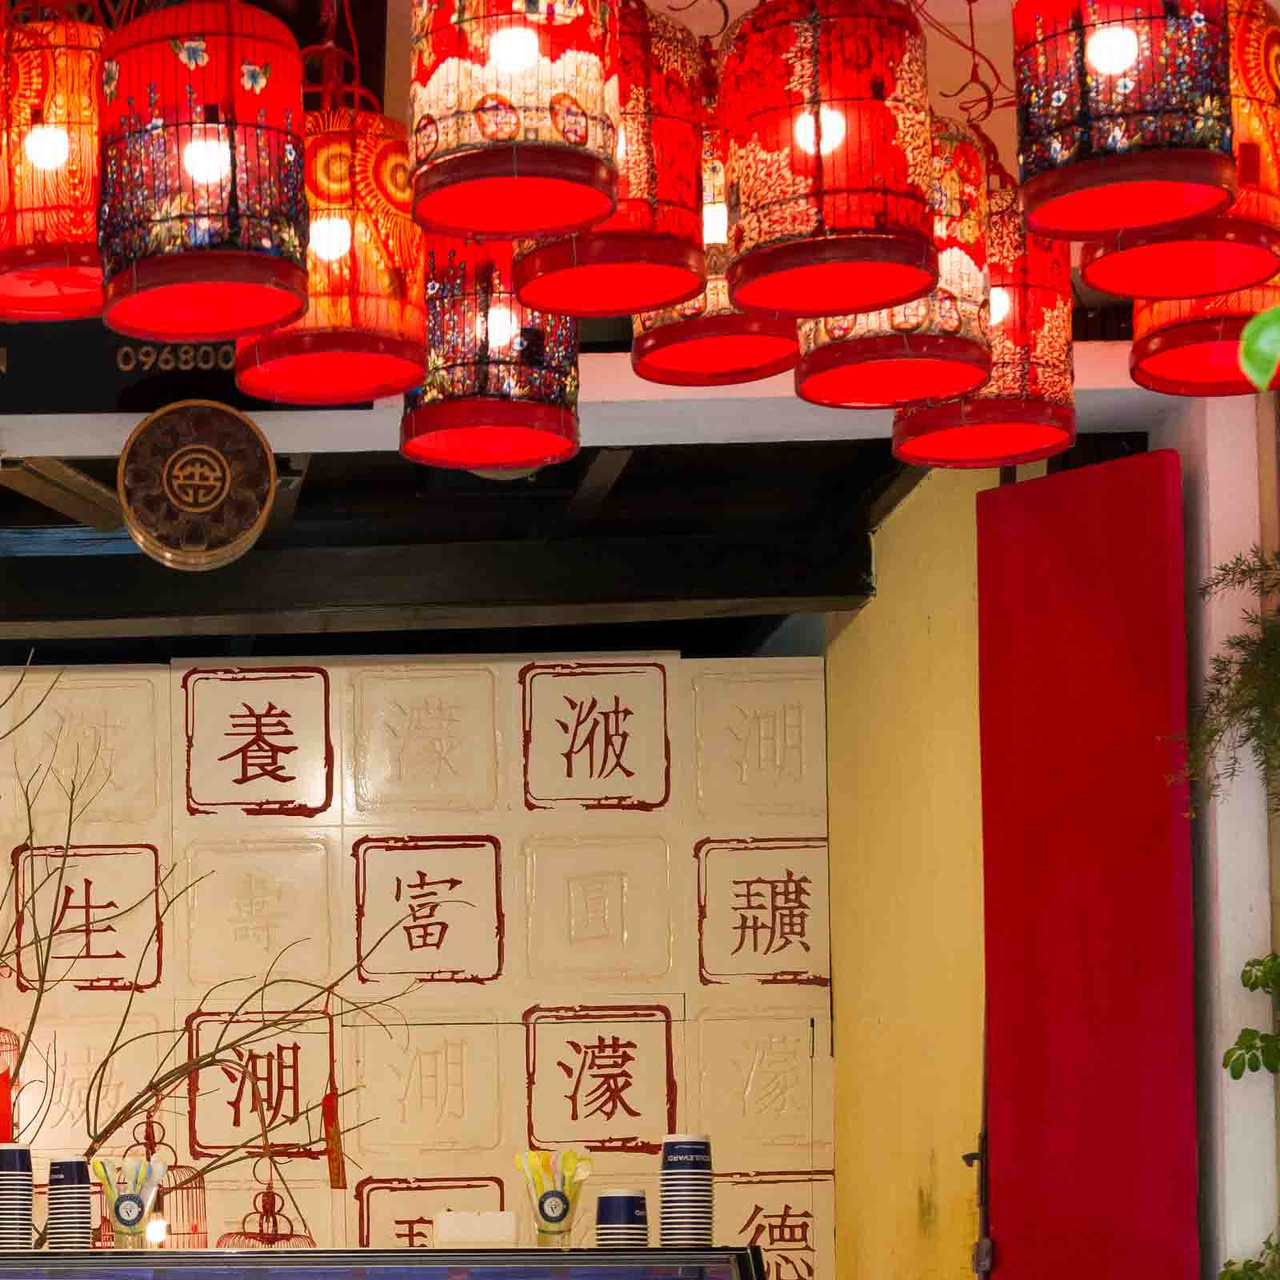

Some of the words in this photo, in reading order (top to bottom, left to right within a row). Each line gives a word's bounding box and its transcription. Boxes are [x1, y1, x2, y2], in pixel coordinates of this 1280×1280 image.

[218, 701, 299, 785] 養
[50, 877, 128, 961] 生
[394, 871, 463, 952] 富
[557, 1035, 642, 1121] 濛
